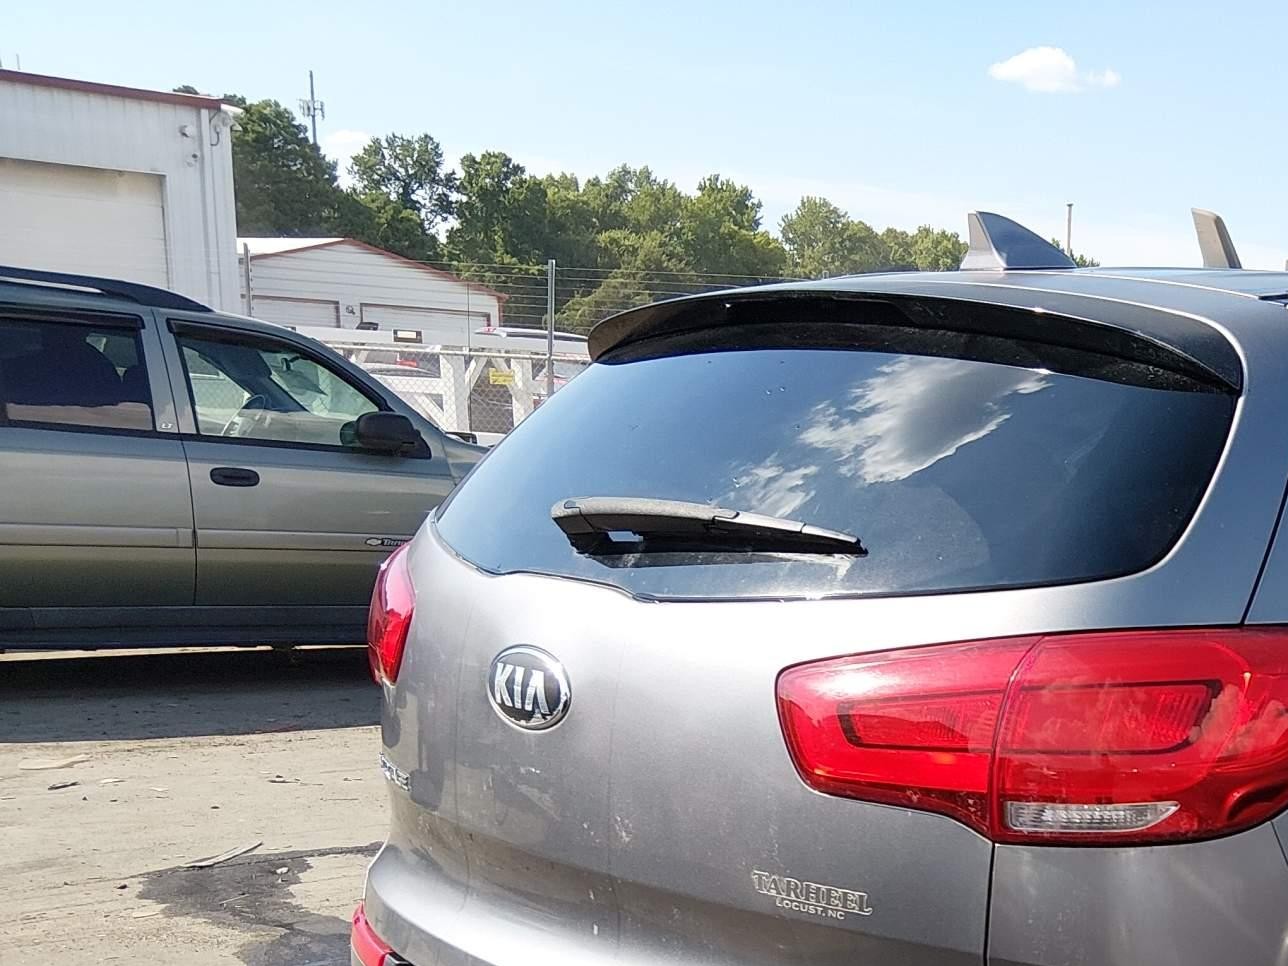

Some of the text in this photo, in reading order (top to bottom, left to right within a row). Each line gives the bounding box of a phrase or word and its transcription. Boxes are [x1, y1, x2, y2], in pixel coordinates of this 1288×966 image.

[494, 662, 551, 714] KIA
[752, 870, 873, 915] TARHEEL
[827, 909, 846, 920] NC
